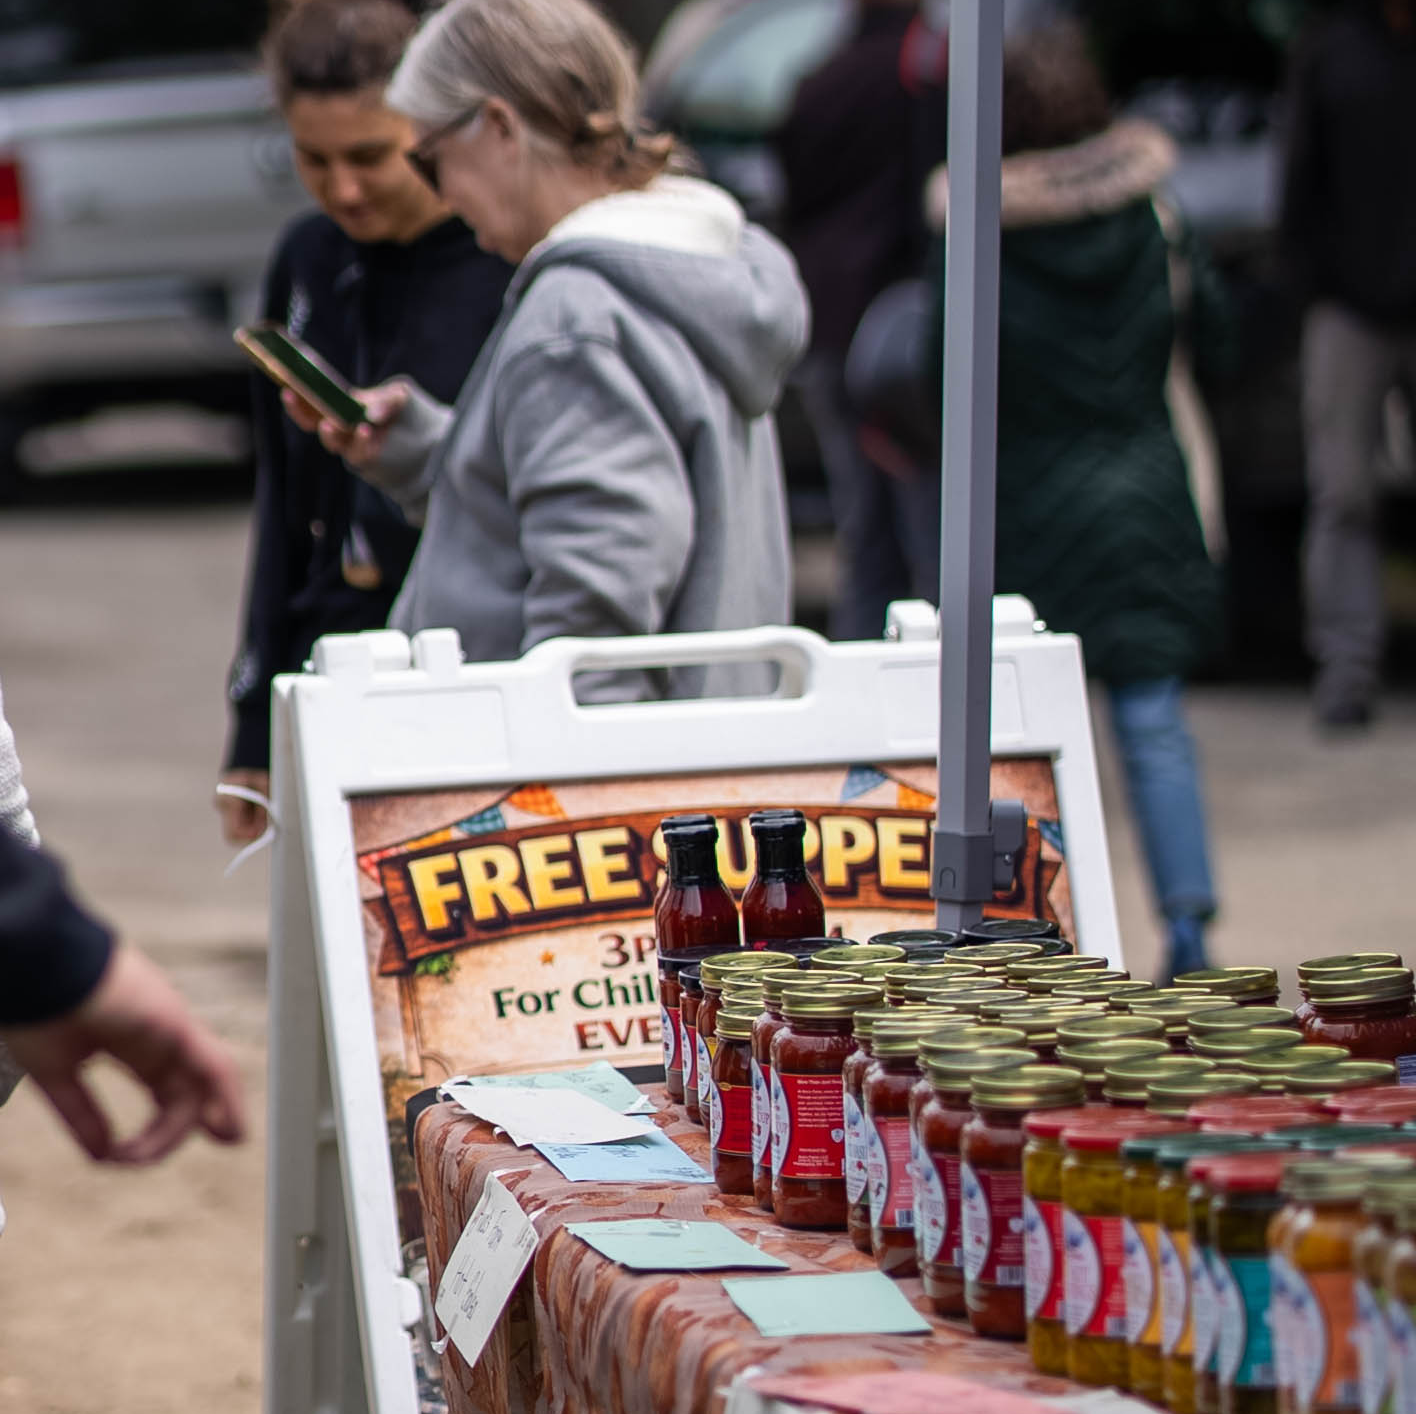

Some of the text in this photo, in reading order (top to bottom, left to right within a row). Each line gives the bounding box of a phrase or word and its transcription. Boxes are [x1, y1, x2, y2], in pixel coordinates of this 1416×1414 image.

[406, 825, 643, 932] FREE
[493, 973, 661, 1018] For Chil
